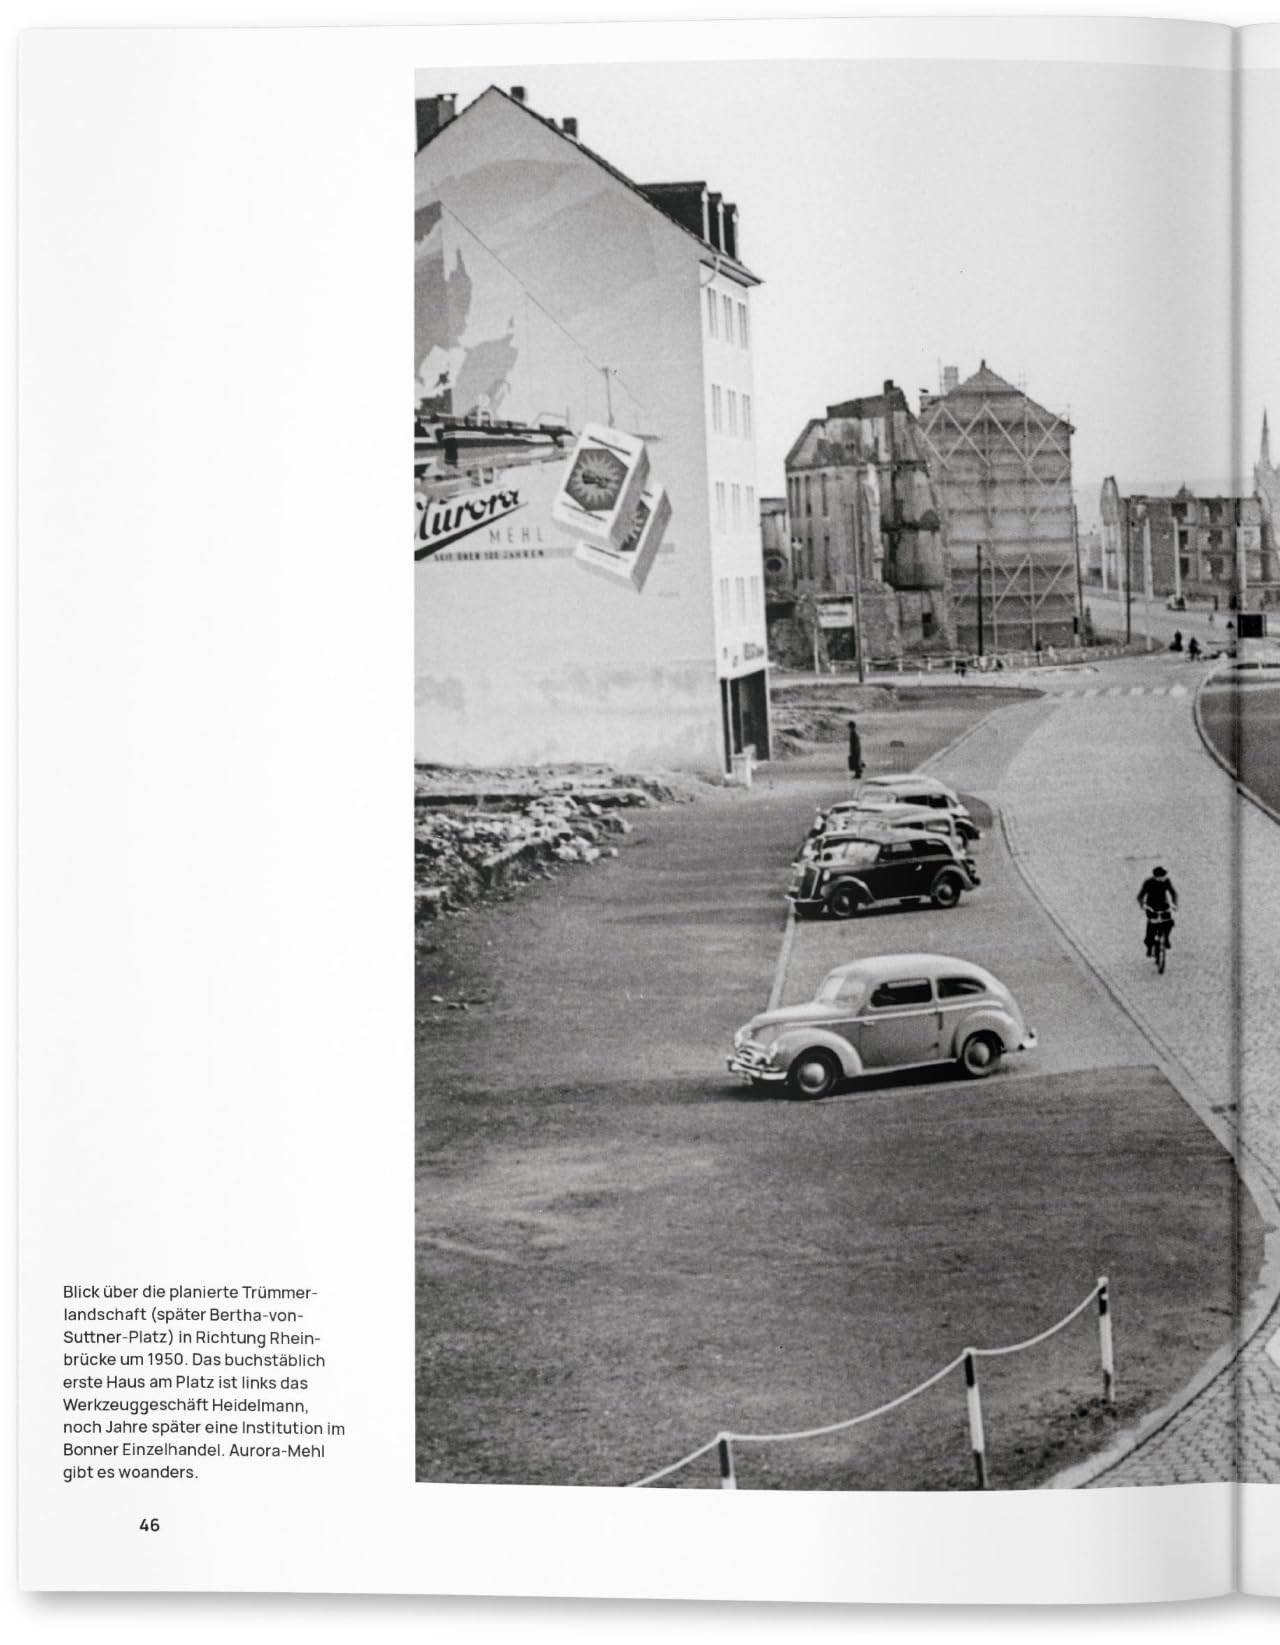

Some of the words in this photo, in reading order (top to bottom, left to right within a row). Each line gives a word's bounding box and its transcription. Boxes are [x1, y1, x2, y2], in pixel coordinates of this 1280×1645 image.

[488, 526, 545, 544] MEHL
[434, 552, 453, 562] SEIT
[503, 549, 545, 560] JAHREN
[64, 1285, 99, 1298] Blick
[104, 1285, 138, 1298] über
[143, 1285, 165, 1298] die
[170, 1285, 238, 1301] planierte
[242, 1286, 317, 1299] Trümmer-
[65, 1308, 146, 1320] landschaft
[152, 1307, 206, 1324] (später
[210, 1308, 303, 1322] Bertha-von-
[64, 1329, 173, 1345] Suttner-Platz)
[179, 1331, 191, 1343] in
[196, 1331, 265, 1348] Richtung
[271, 1332, 320, 1344] Rhein-
[64, 1353, 116, 1366] brücke
[121, 1356, 143, 1365] um
[148, 1353, 187, 1365] 1950.
[193, 1353, 221, 1366] Das
[225, 1354, 325, 1367] buchstäblich
[63, 1376, 102, 1388] erste
[107, 1376, 145, 1388] Haus
[150, 1378, 172, 1388] am
[177, 1376, 214, 1388] Platz
[219, 1376, 237, 1388] ist
[243, 1376, 276, 1389] links
[281, 1377, 308, 1389] das
[63, 1398, 208, 1415] Werkzeuggeschäft
[213, 1399, 308, 1414] Heidelmann,
[64, 1421, 101, 1433] noch
[106, 1421, 147, 1433] Jahre
[152, 1420, 201, 1436] später
[205, 1421, 238, 1433] eine
[243, 1421, 322, 1434] Institution
[328, 1423, 344, 1435] im
[64, 1443, 119, 1456] Bonner
[123, 1443, 224, 1456] Einzelhandel.
[229, 1444, 324, 1457] Aurora-Mehl
[63, 1466, 93, 1482] gibt
[97, 1468, 114, 1478] es
[119, 1466, 198, 1478] woanders.
[140, 1519, 159, 1531] 46
